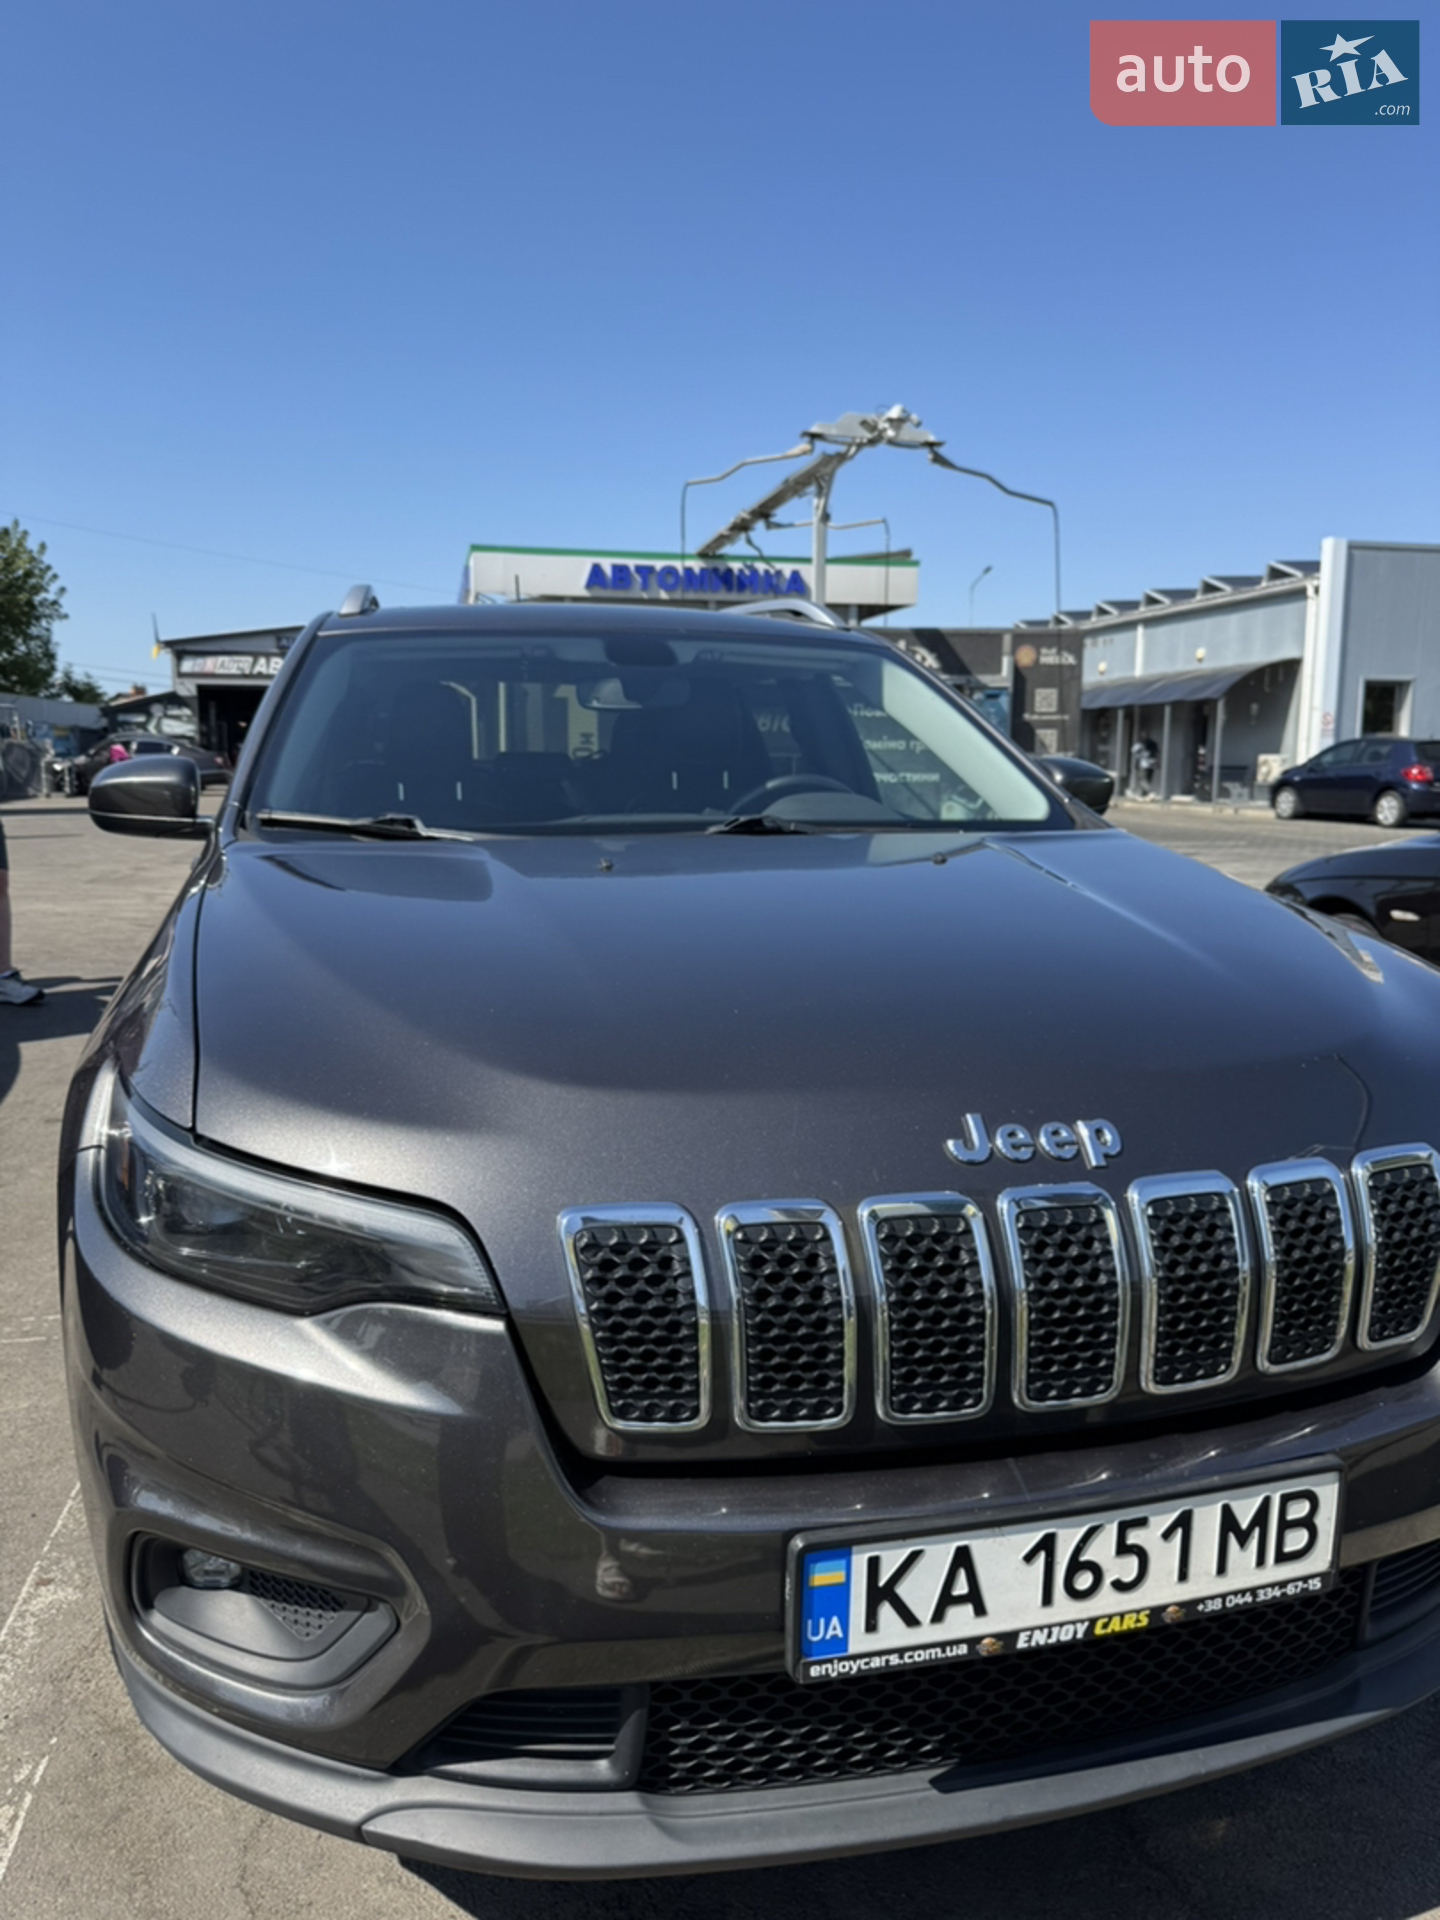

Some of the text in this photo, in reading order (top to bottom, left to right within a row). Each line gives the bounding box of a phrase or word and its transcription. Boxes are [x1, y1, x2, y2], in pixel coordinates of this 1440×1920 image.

[584, 562, 808, 595] АВТОМИЙКА
[945, 1112, 1122, 1169] Jeep
[864, 1544, 988, 1635] KA
[1196, 1577, 1323, 1613] +38 044 334-67-15
[806, 1616, 844, 1642] UA
[1016, 1610, 1151, 1649] ENJOY CARS
[810, 1643, 969, 1678] enjoycars.com.ua
